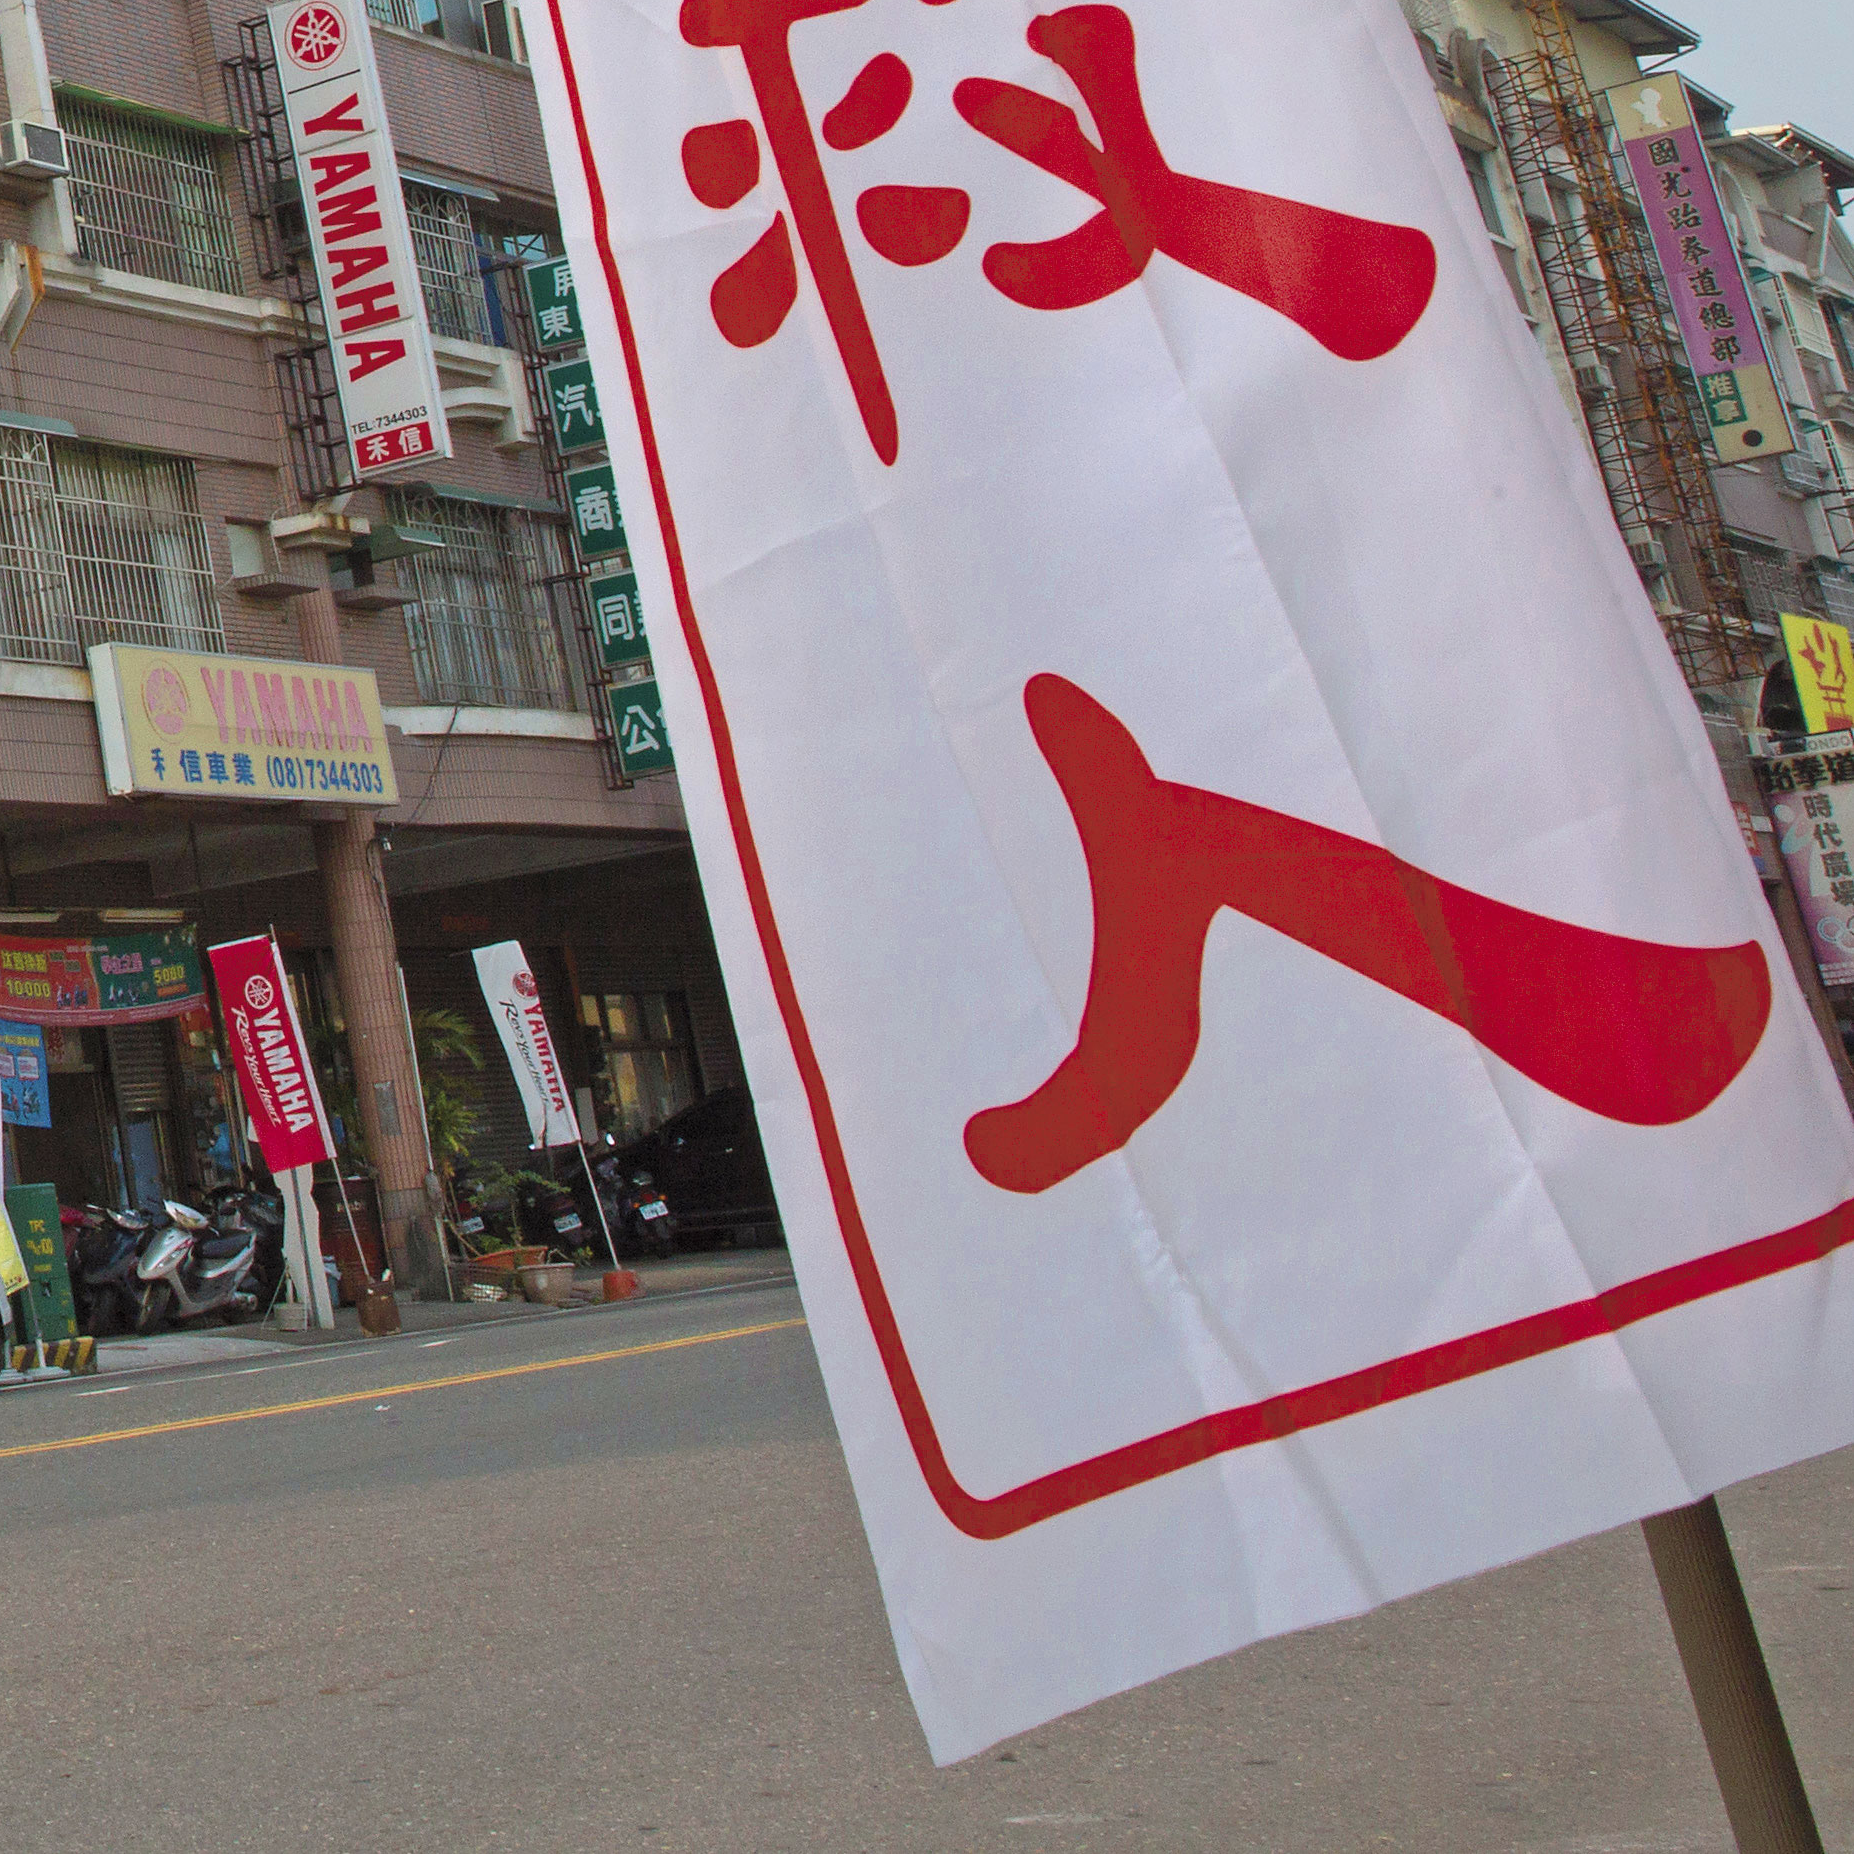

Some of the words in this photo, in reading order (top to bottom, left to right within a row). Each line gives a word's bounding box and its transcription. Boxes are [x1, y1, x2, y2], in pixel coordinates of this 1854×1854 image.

[303, 92, 406, 383] YAMAHA
[1648, 137, 1741, 364] 國光跆拳道總部
[352, 404, 428, 435] TEL:7344303
[366, 420, 423, 462] 禾信
[200, 666, 373, 754] YAMAHA
[151, 748, 255, 786] 禾信車業
[266, 755, 384, 794] (08)7344303
[5, 978, 51, 998] 10000
[253, 1006, 314, 1133] YAMAHA
